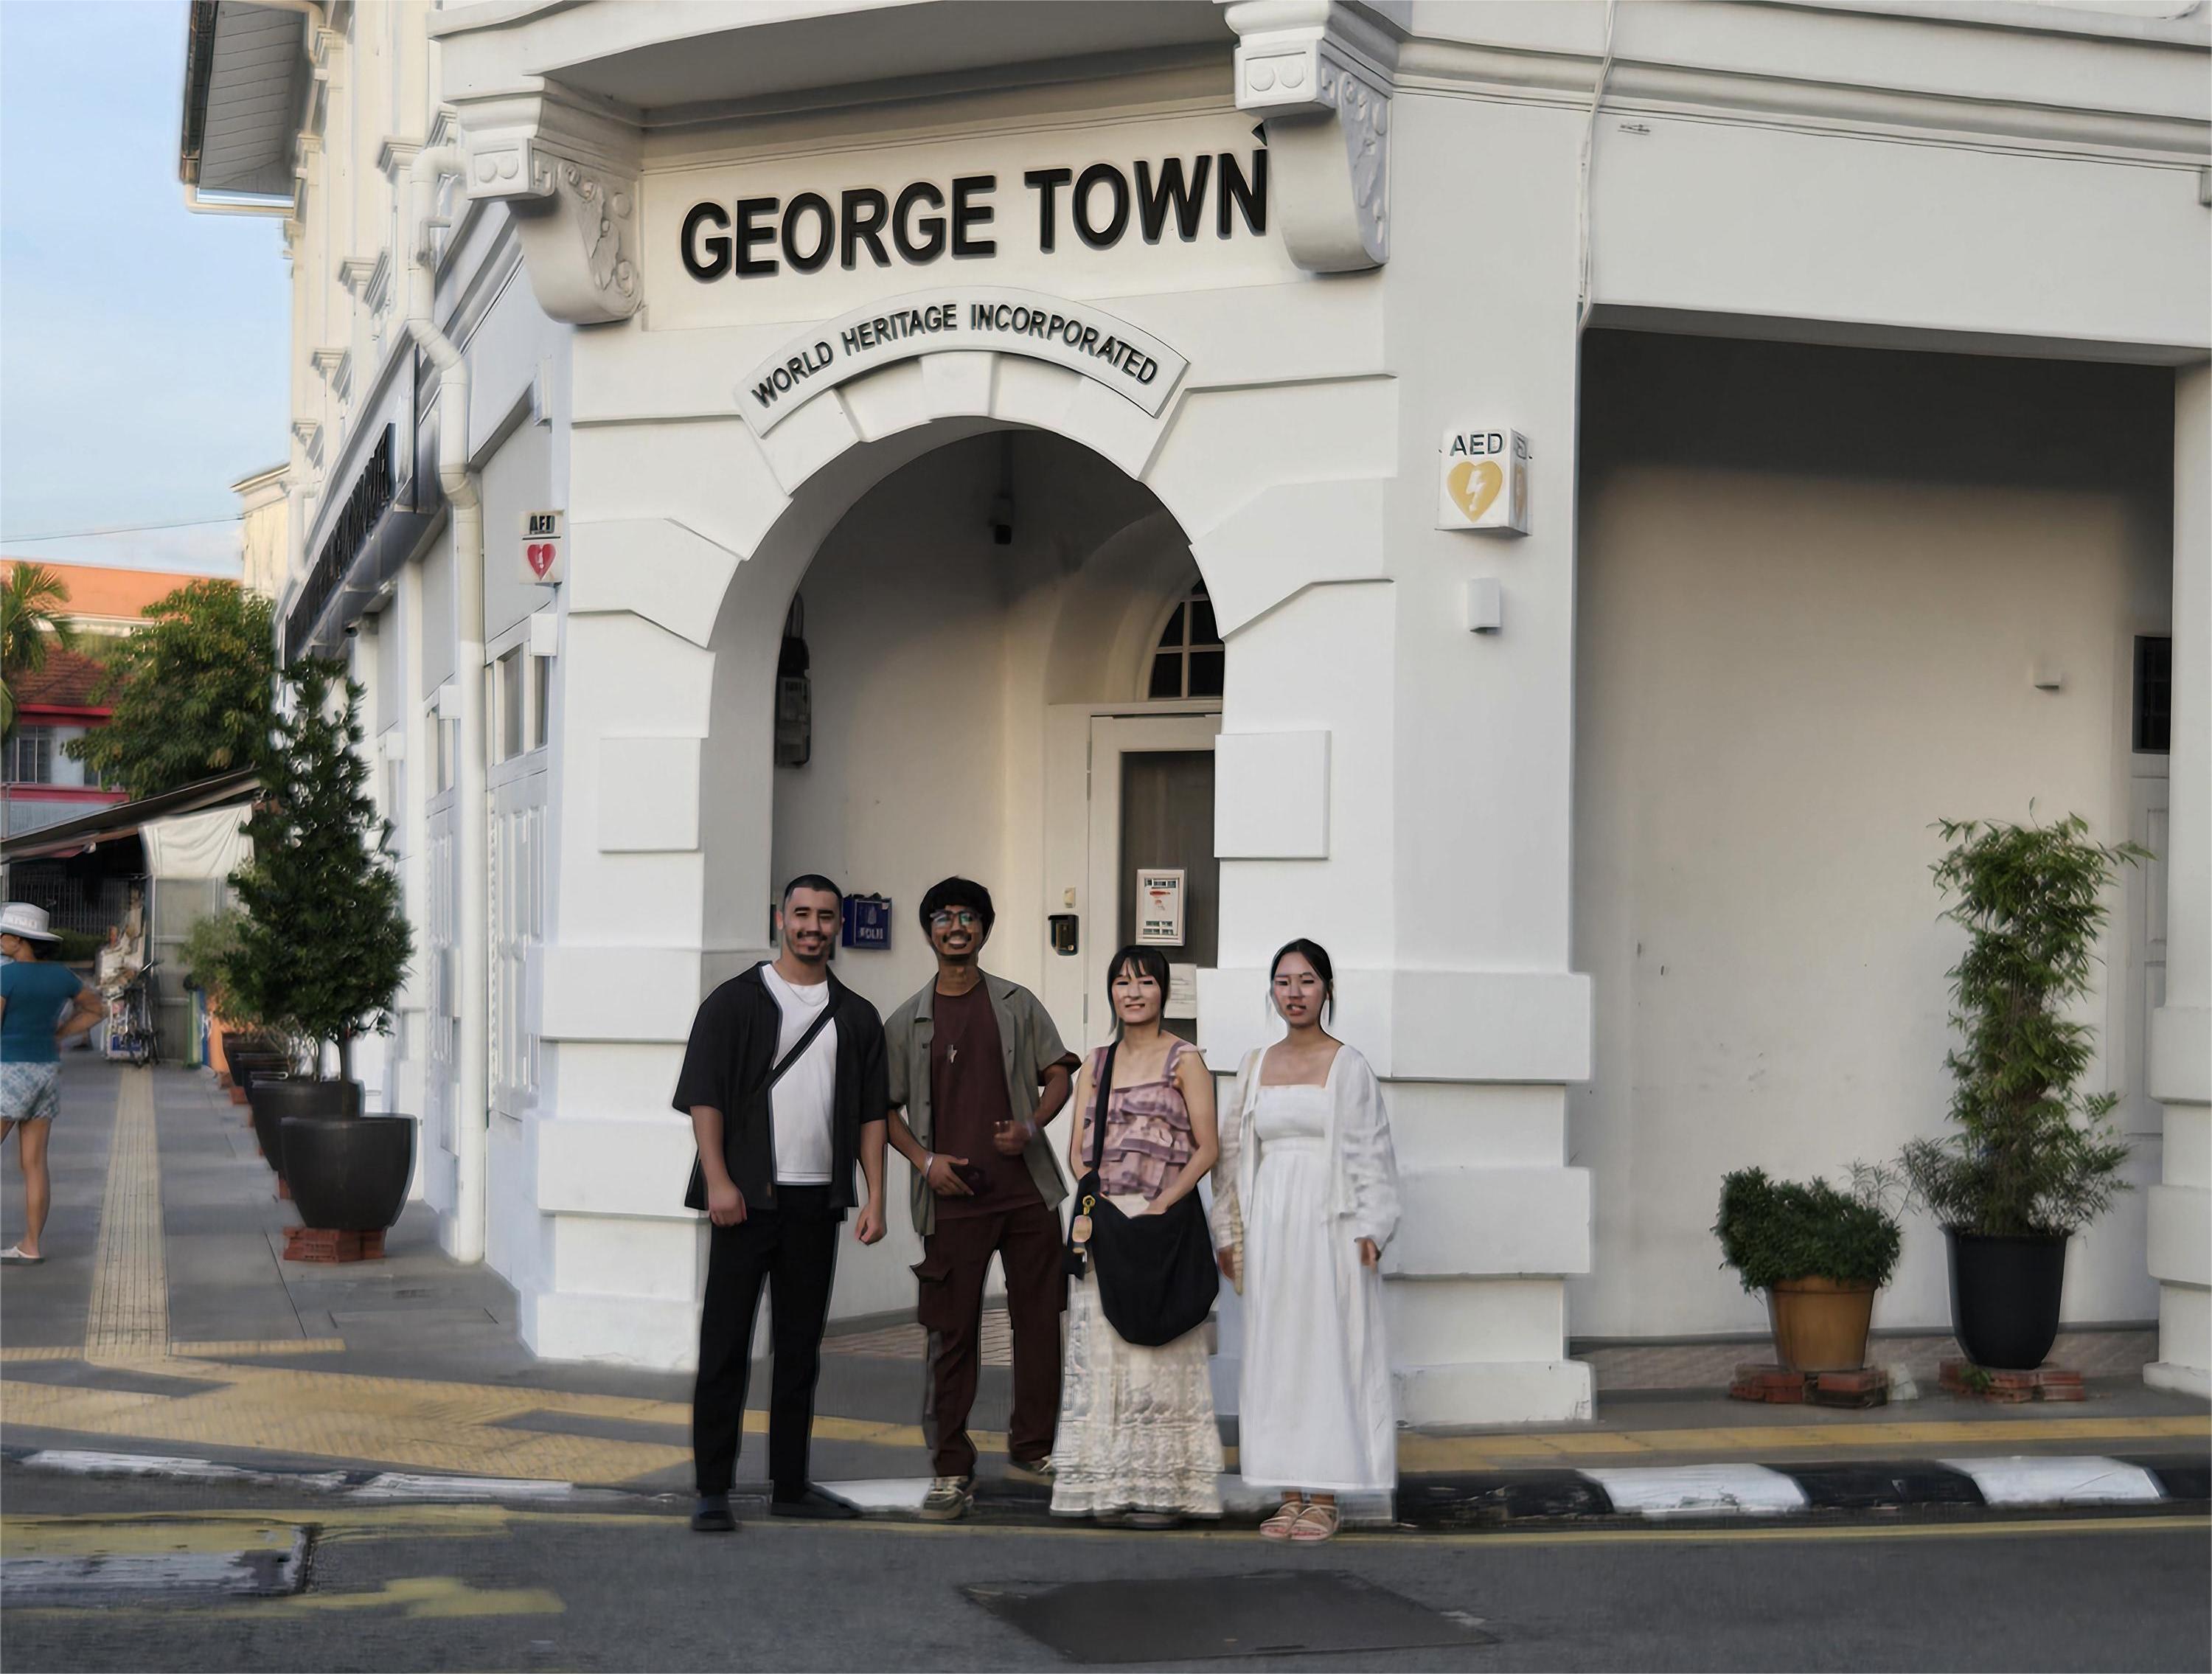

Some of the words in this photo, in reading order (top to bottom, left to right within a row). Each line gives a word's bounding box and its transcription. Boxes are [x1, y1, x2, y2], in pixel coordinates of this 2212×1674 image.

[680, 175, 998, 282] GEORGE
[1024, 148, 1268, 254] TOWN
[751, 340, 835, 409] WORLD
[840, 302, 959, 358] HERITAGE
[969, 302, 1160, 387] INCORPORATED
[1450, 433, 1503, 456] AED
